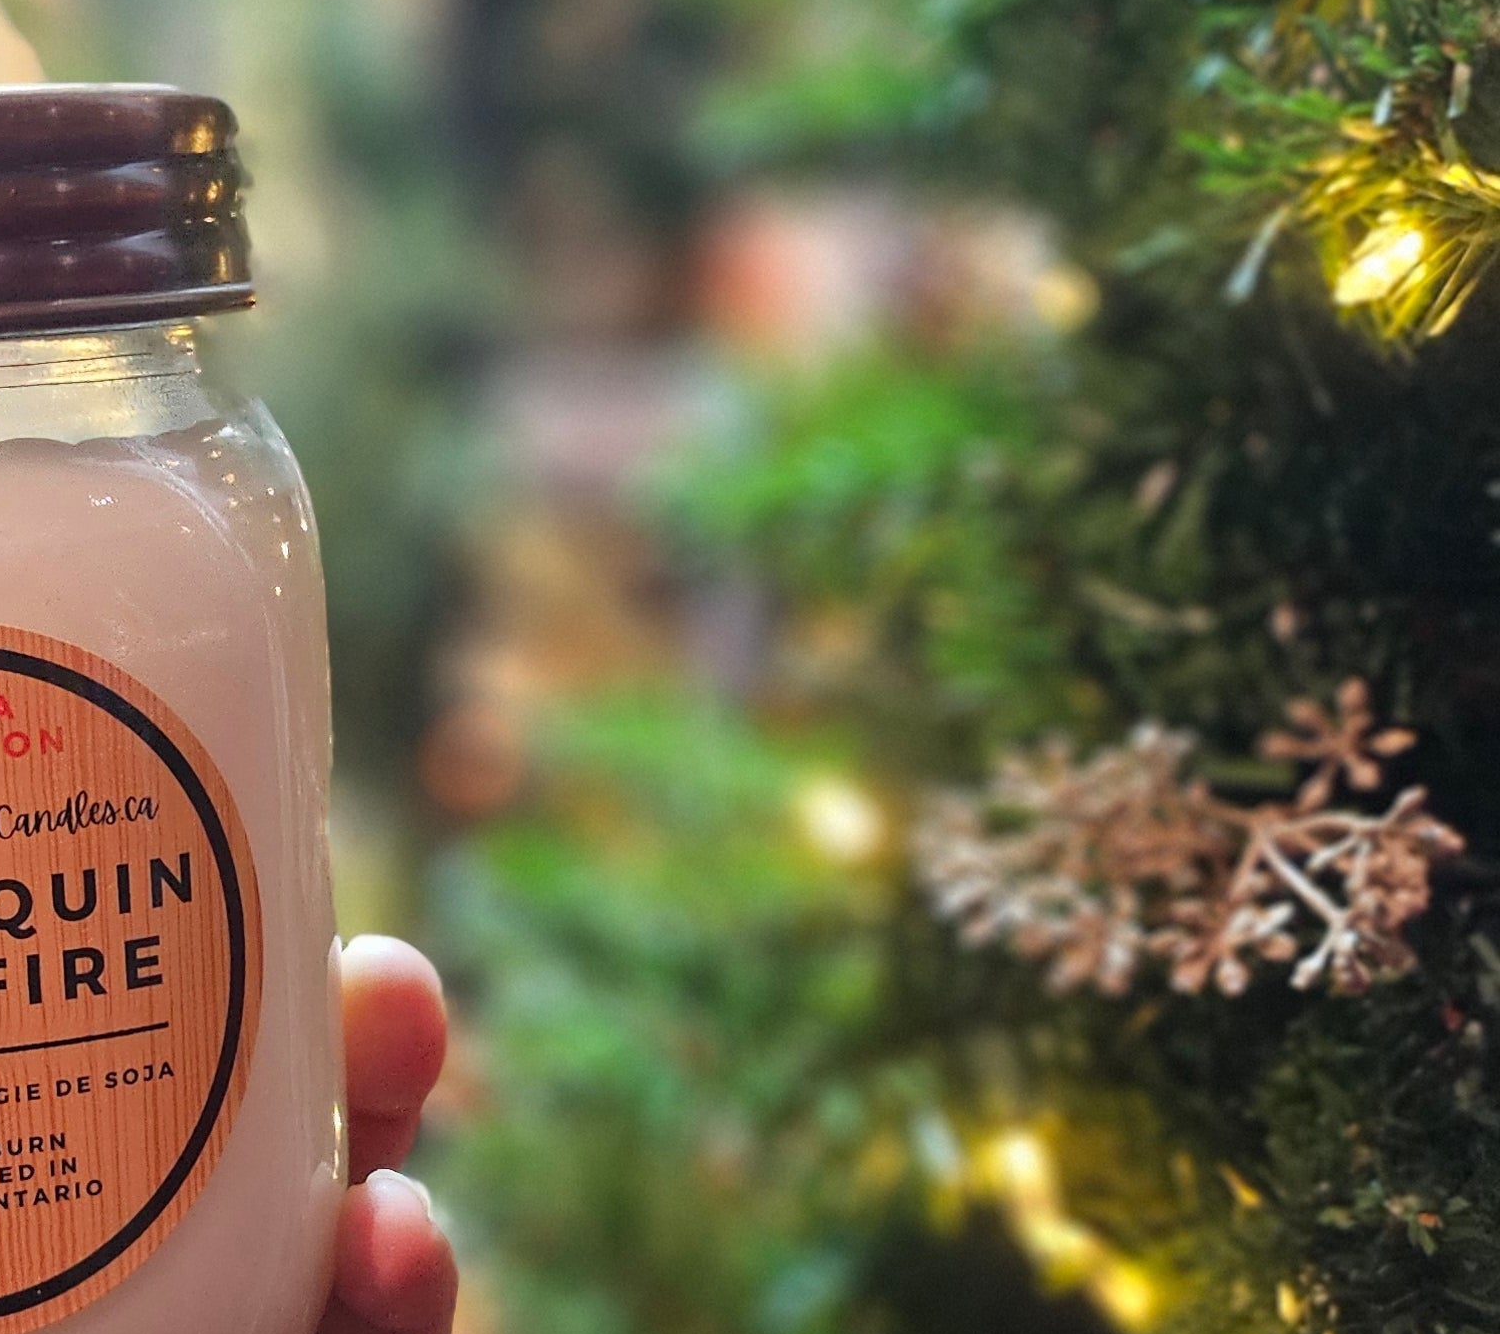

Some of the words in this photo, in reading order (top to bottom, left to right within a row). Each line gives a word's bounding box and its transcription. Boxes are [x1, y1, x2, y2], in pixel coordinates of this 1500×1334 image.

[55, 1075, 92, 1097] DE
[104, 1060, 175, 1090] SOJA
[49, 1157, 78, 1178] IN
